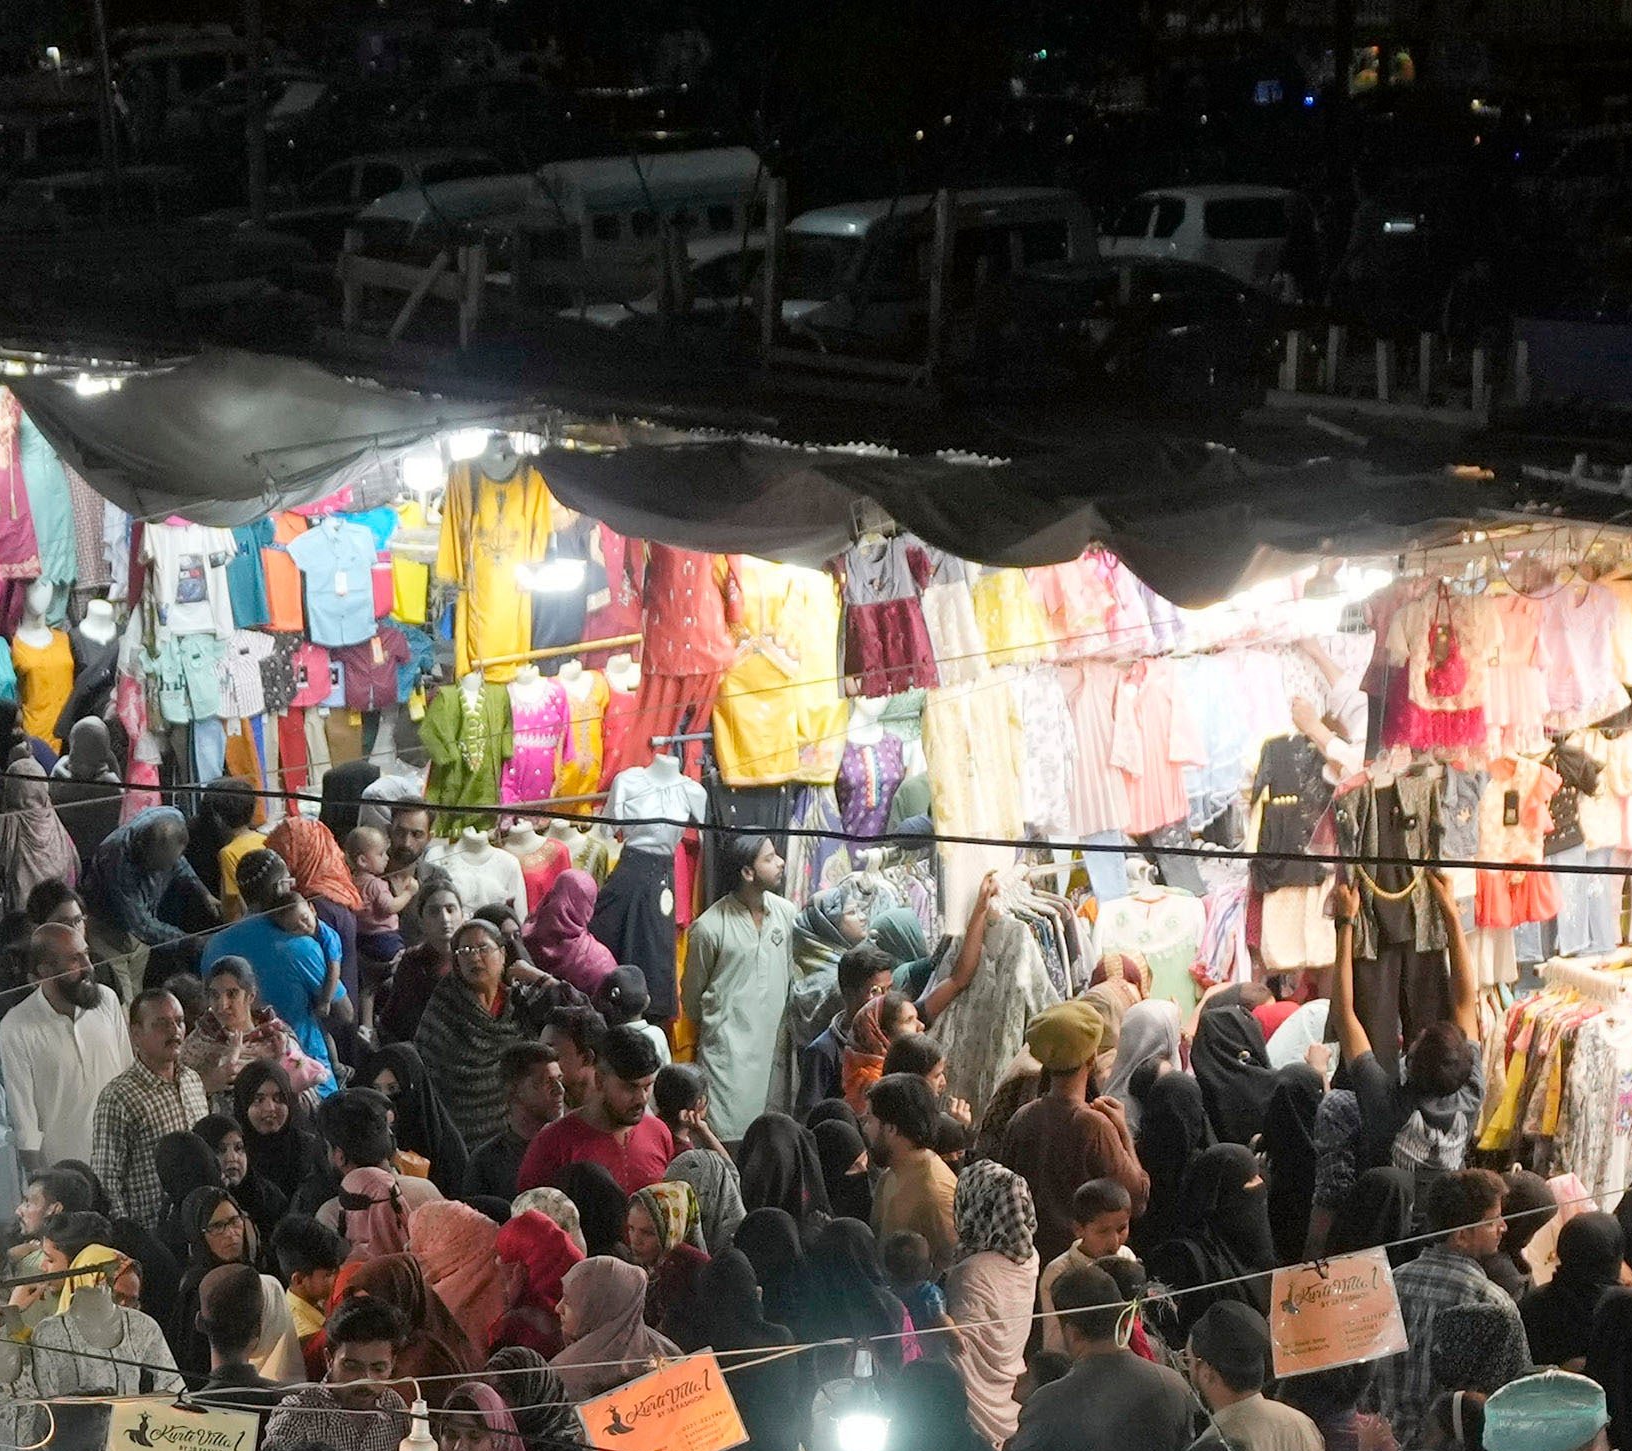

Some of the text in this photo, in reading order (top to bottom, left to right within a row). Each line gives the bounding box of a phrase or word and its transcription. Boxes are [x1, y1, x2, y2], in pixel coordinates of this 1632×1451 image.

[626, 1395, 666, 1425] Kurti
[150, 1424, 196, 1444] Kurti
[197, 1429, 235, 1449] Villa
